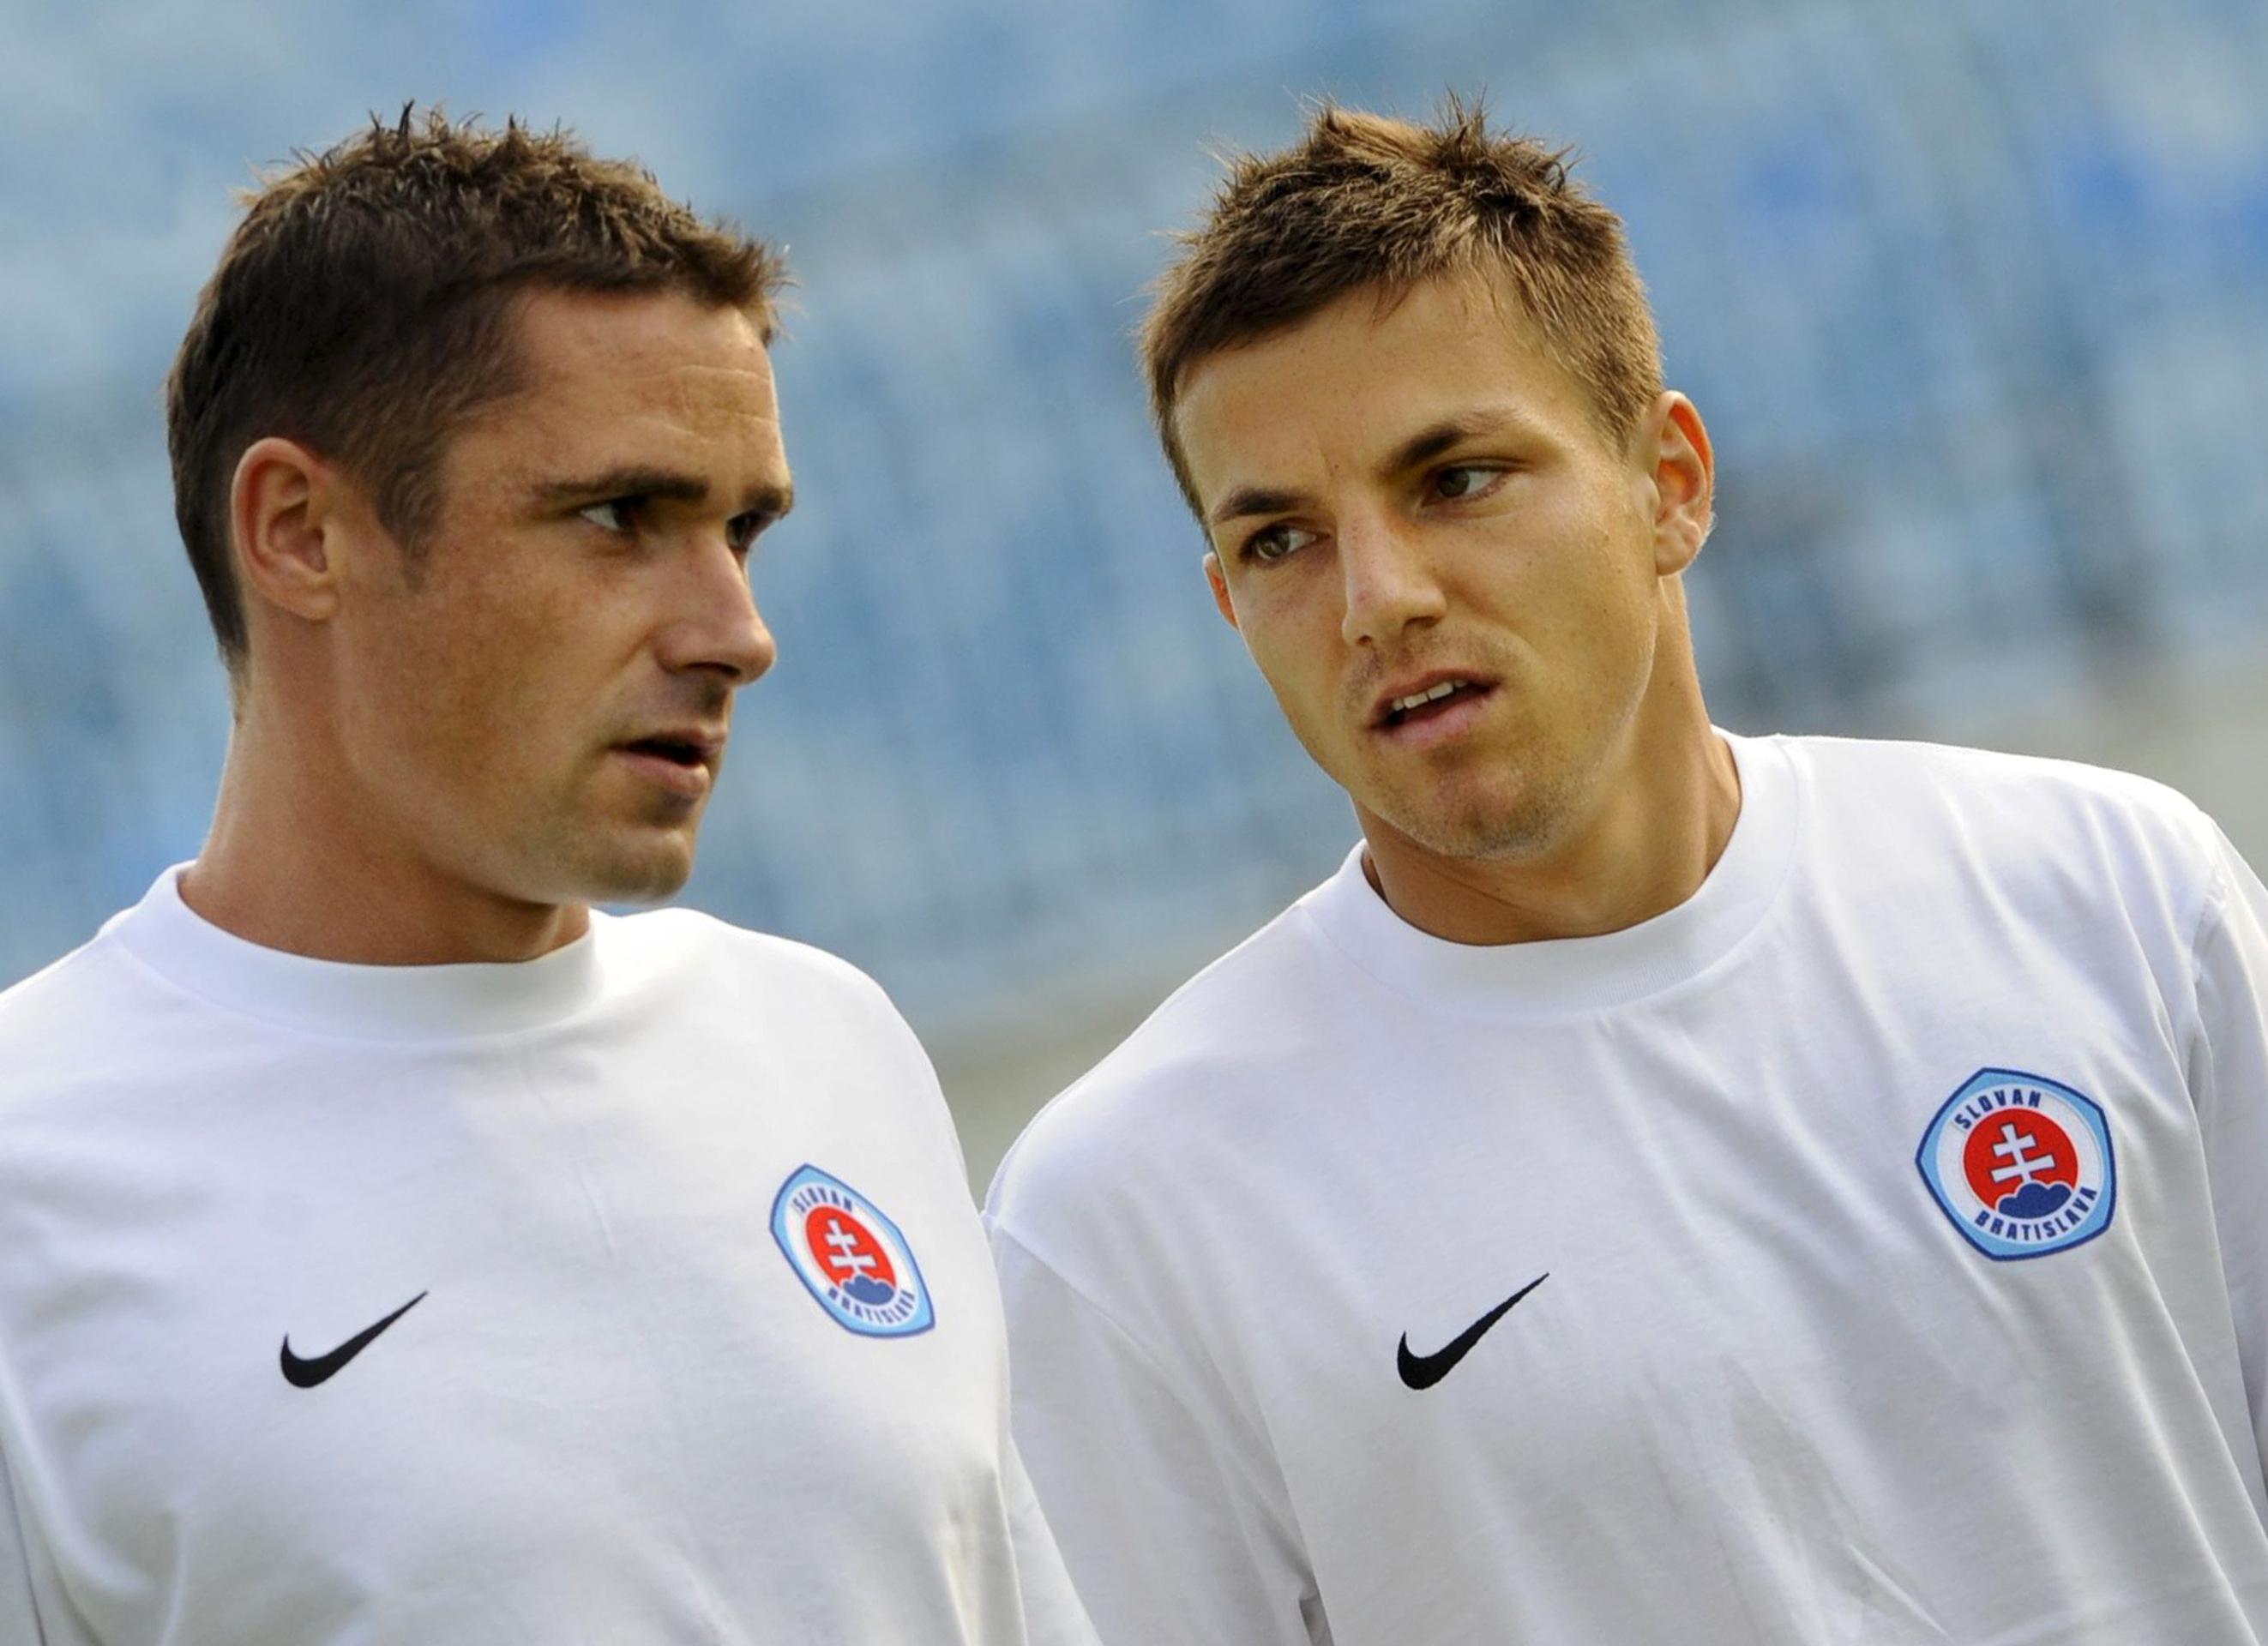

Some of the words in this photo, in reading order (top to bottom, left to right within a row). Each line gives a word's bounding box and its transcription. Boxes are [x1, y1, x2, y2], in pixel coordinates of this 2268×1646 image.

[1955, 1089, 2042, 1130] SLOVAN
[793, 1186, 853, 1214] SLOVAN
[1975, 1186, 2097, 1241] BRATISLAVA
